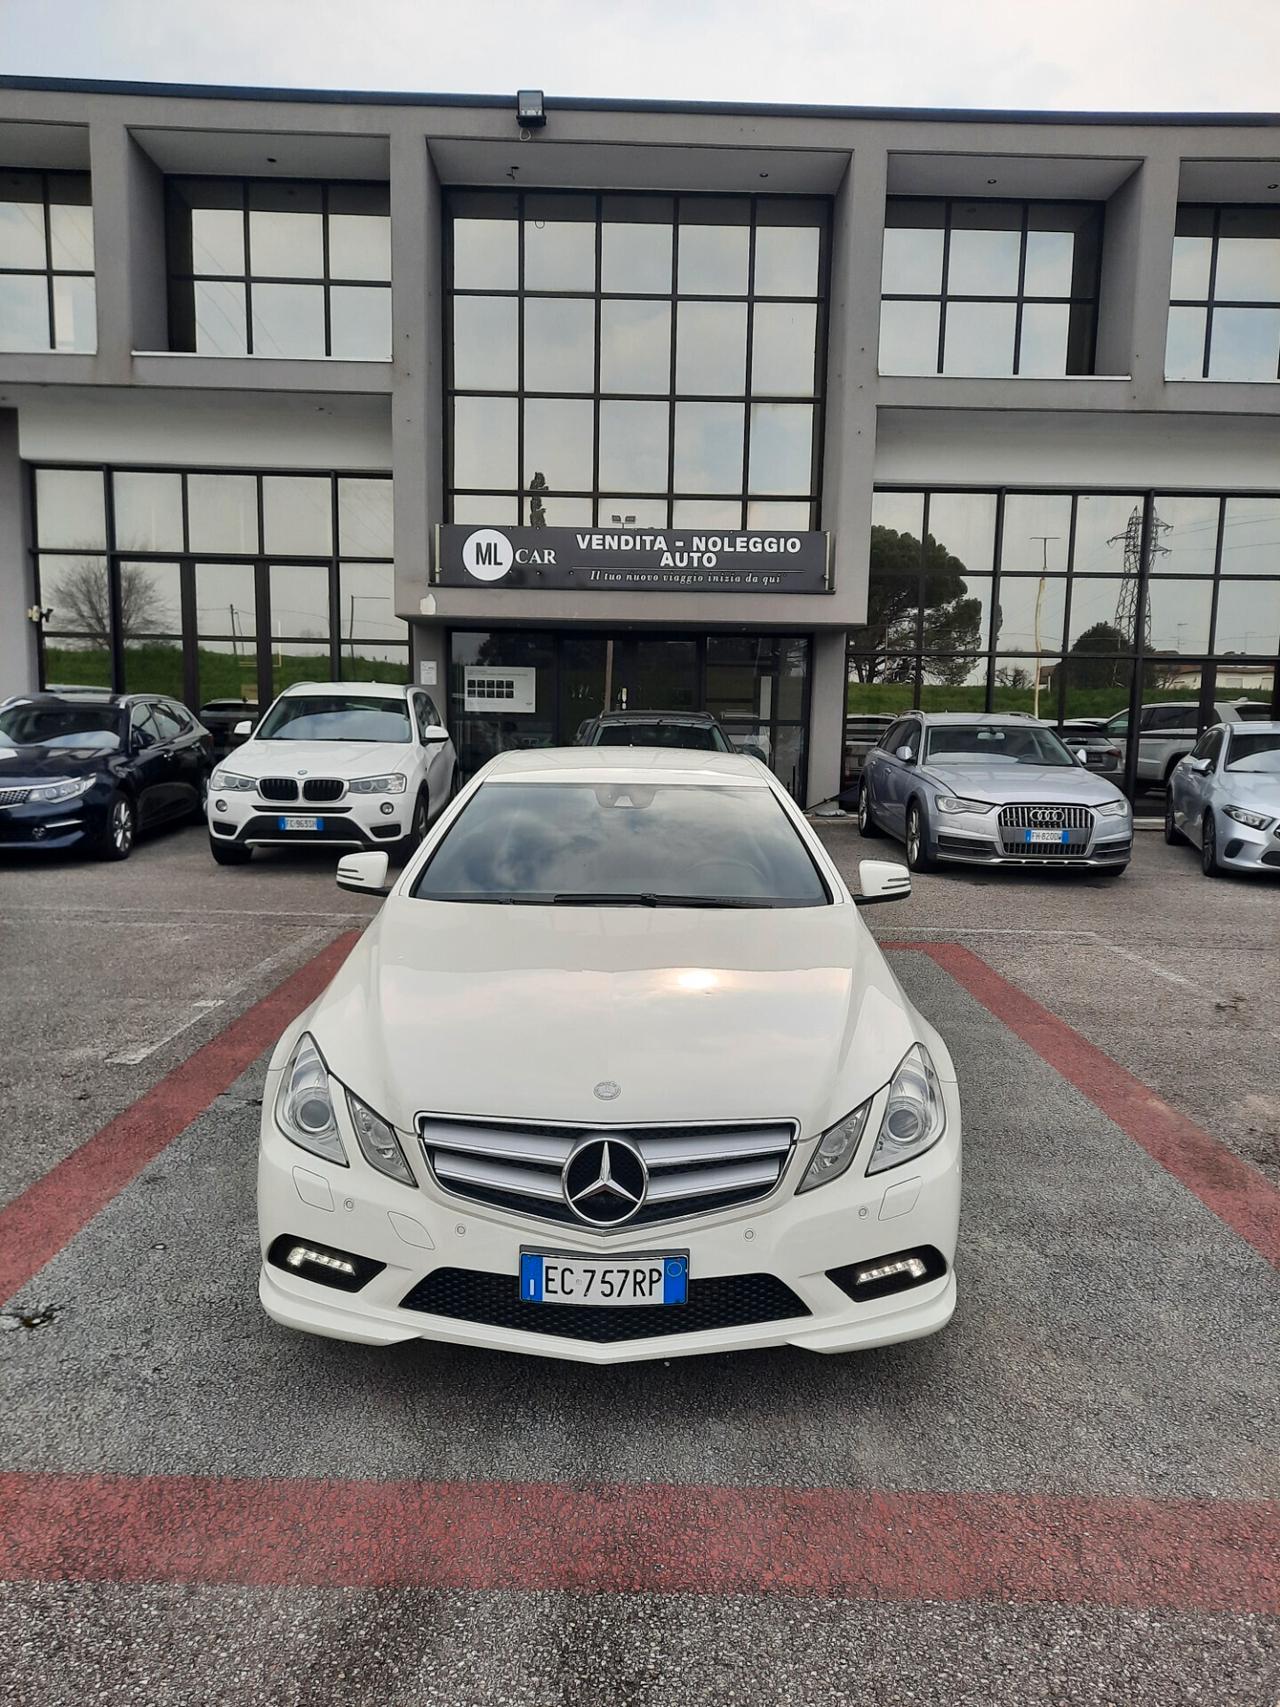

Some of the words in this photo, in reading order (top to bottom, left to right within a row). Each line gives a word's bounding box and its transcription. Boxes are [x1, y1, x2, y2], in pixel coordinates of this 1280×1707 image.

[576, 534, 668, 551] VENDITA
[692, 536, 801, 553] NOLEGGIO
[475, 542, 503, 566] ML
[515, 548, 557, 564] CAR
[660, 551, 717, 568] AUTO
[590, 570, 601, 581] Il
[604, 572, 622, 581] tuo
[626, 573, 659, 582] nuovo
[663, 572, 704, 585] viaggio
[708, 572, 741, 583] inizia
[745, 573, 759, 583] da
[762, 573, 782, 586] qui
[544, 1265, 575, 1296] EC
[582, 1267, 663, 1298] 757RP
